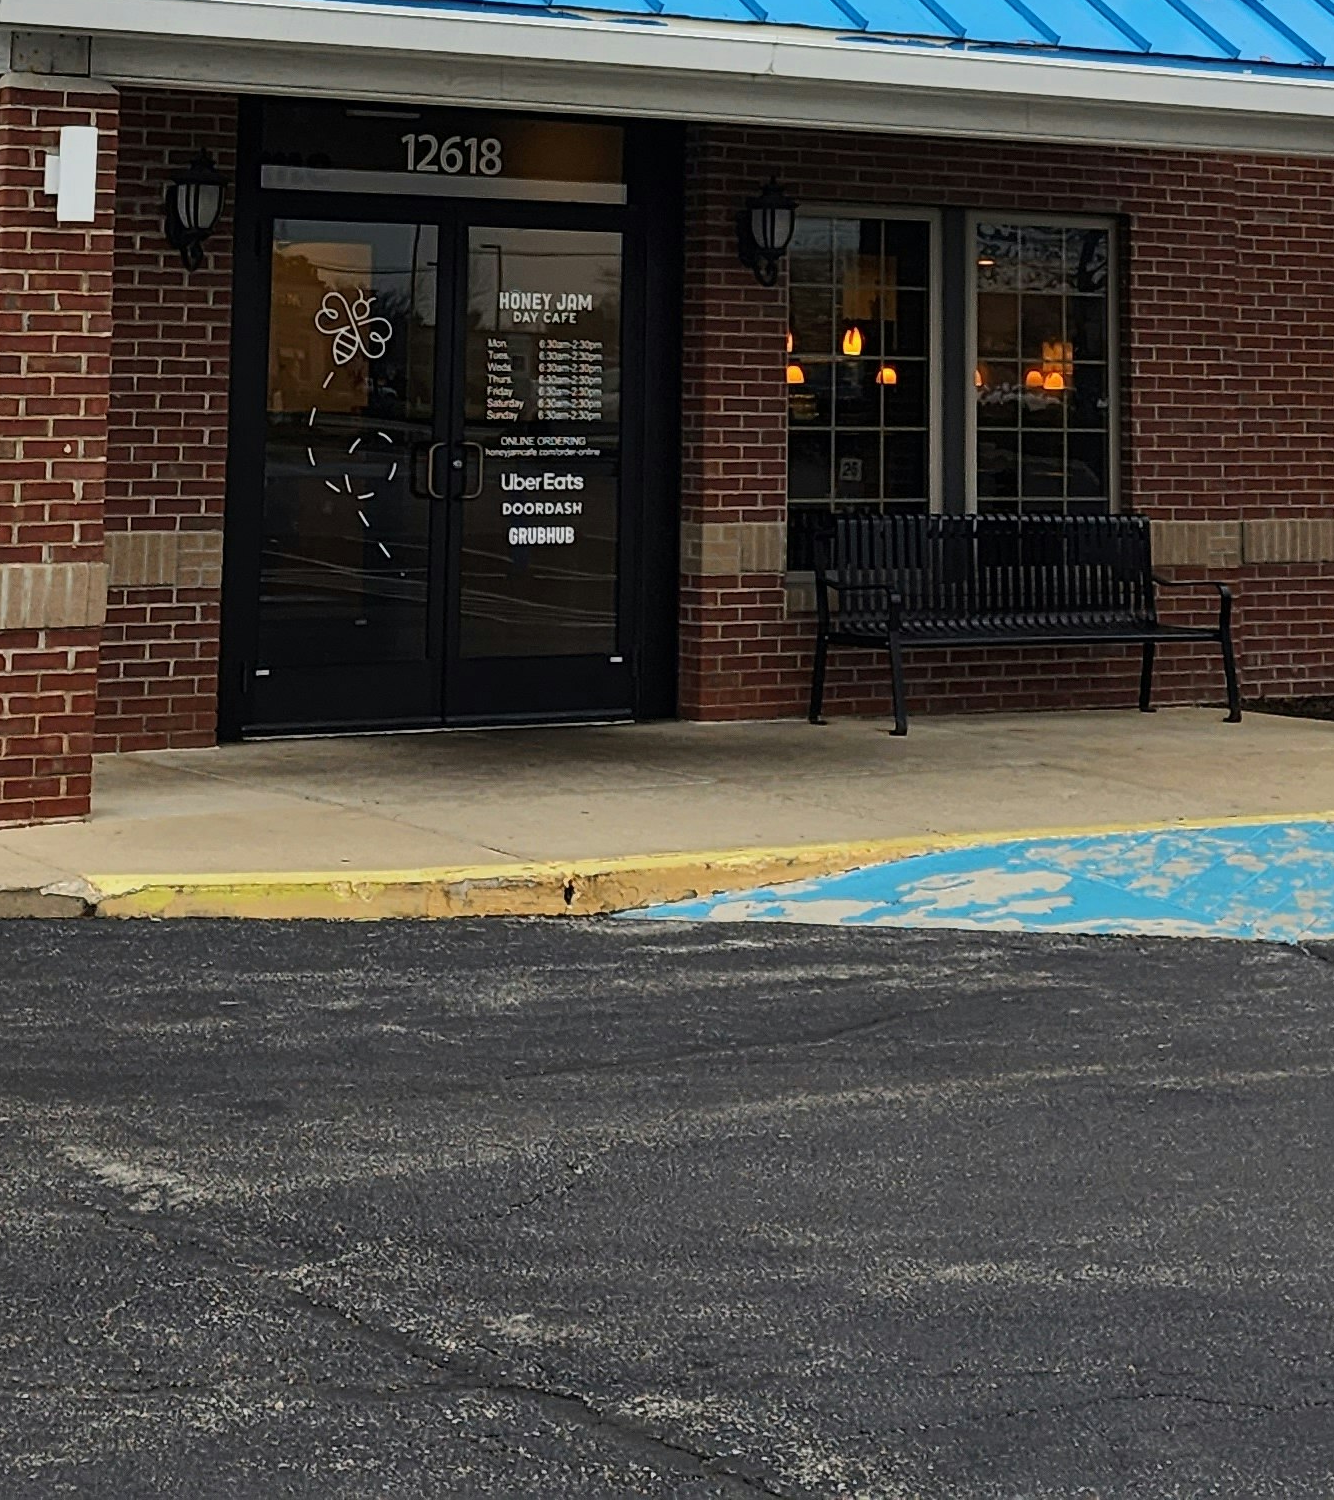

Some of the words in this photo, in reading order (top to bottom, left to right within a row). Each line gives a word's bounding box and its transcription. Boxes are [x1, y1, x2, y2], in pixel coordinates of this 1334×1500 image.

[401, 133, 503, 176] 12618
[499, 291, 552, 310] HONEY
[556, 293, 593, 311] JAM
[513, 311, 539, 323] DAY
[543, 312, 577, 324] CAFE
[487, 386, 514, 398] Friday
[487, 398, 525, 410] Saturday
[487, 410, 519, 422] Sunday
[501, 436, 535, 446] ONLINE
[537, 436, 586, 446] ORDERING
[502, 502, 582, 515] DOORDASH
[508, 526, 575, 546] GRUBHUB
